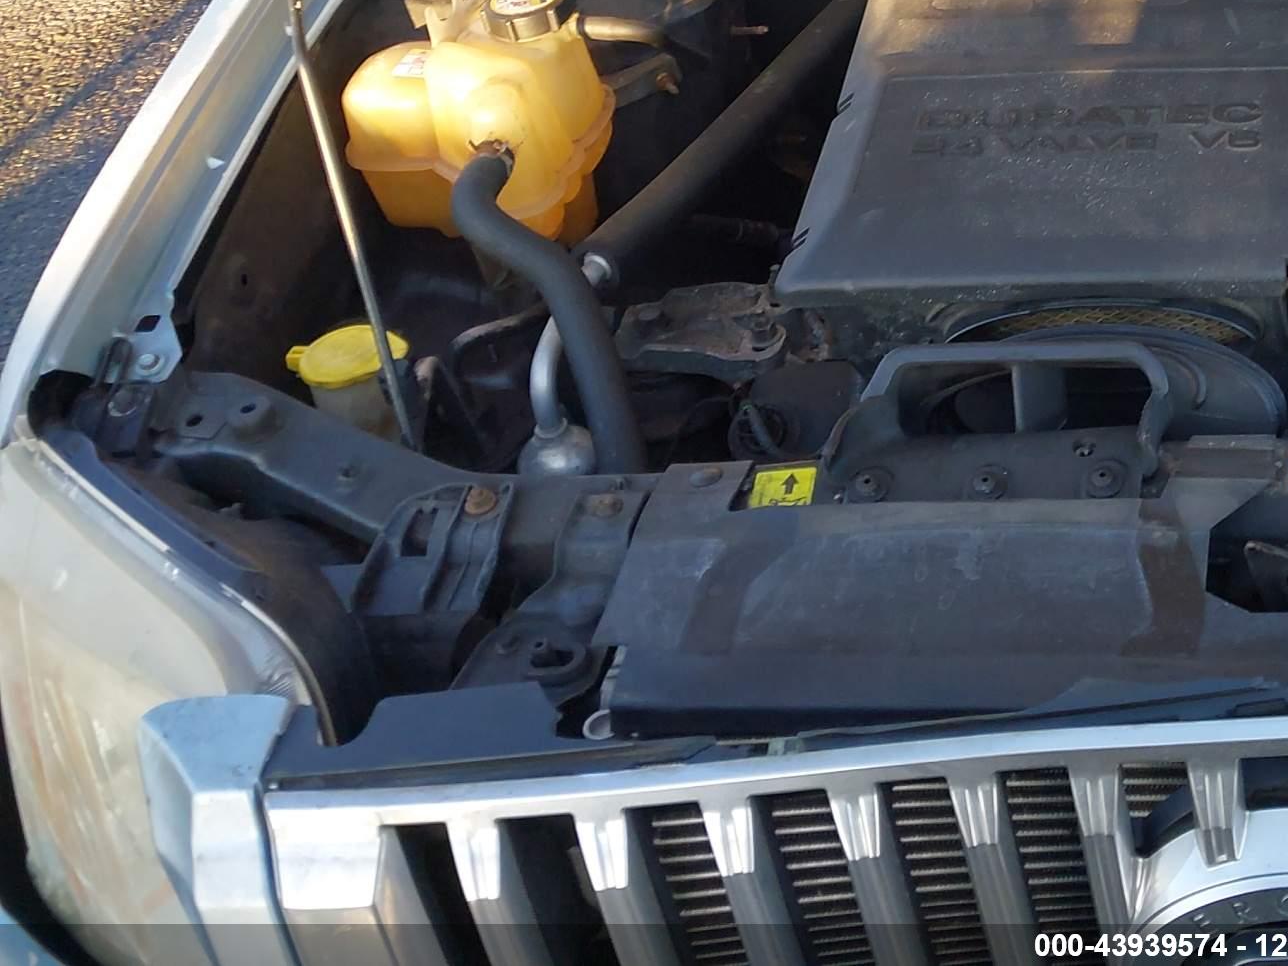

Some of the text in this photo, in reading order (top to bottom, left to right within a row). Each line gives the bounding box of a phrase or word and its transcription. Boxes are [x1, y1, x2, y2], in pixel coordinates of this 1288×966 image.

[909, 103, 1264, 131] DURATEC
[1001, 132, 1159, 153] VALVE
[1187, 129, 1263, 152] V6
